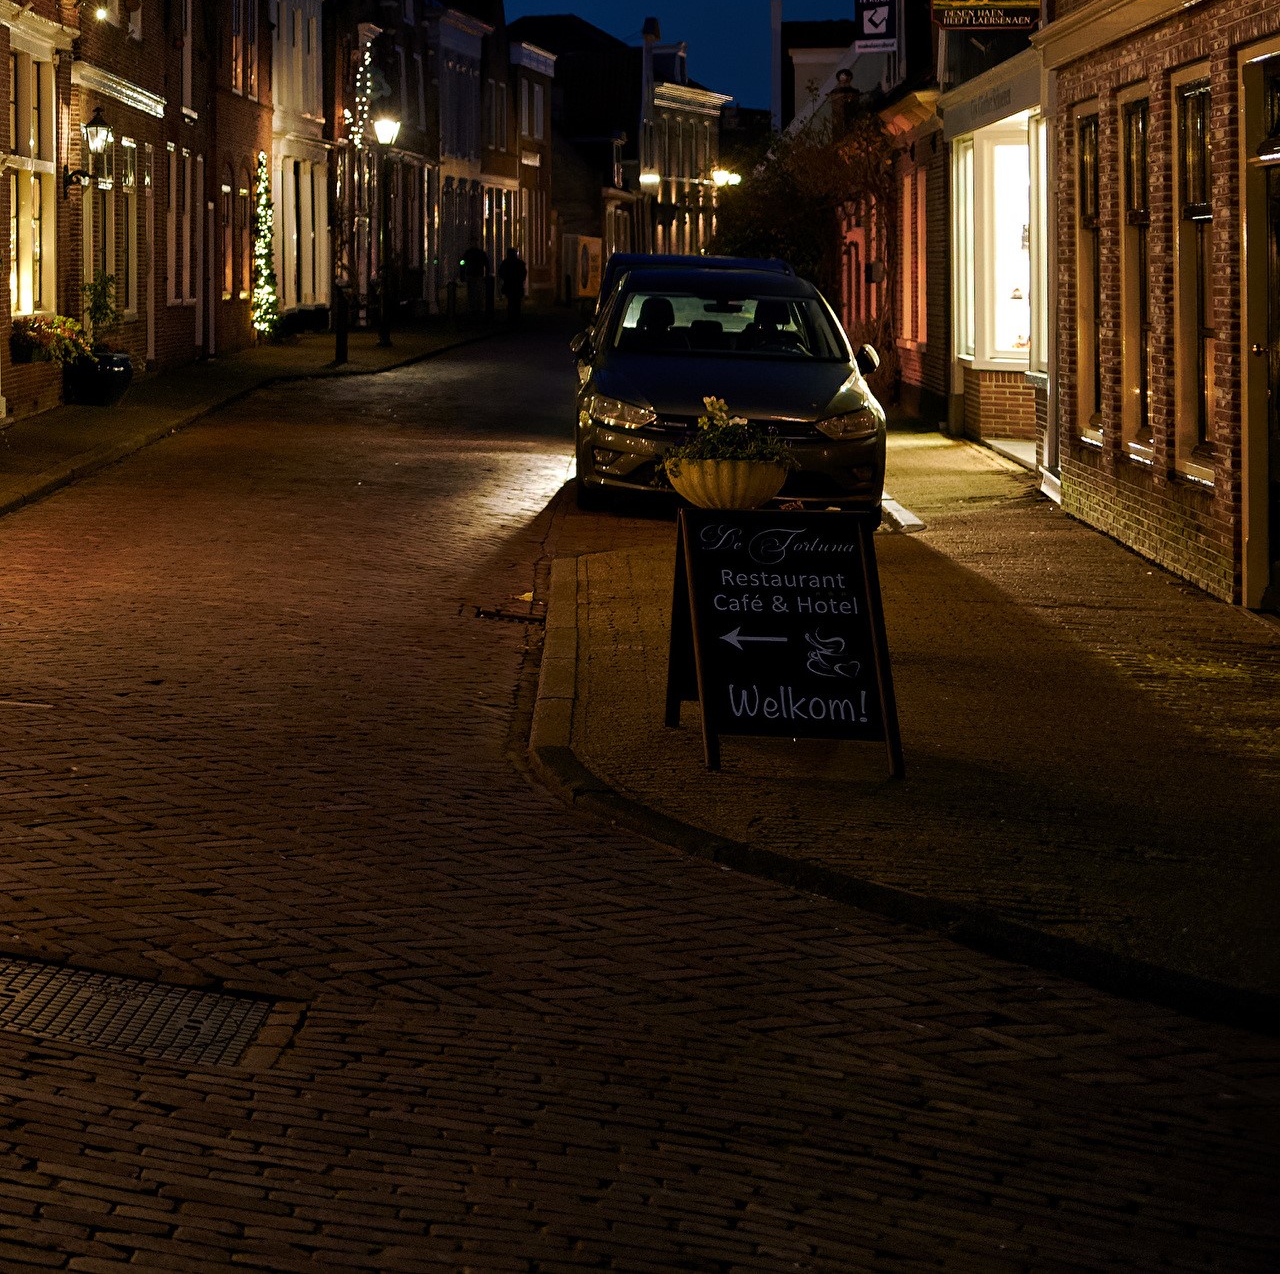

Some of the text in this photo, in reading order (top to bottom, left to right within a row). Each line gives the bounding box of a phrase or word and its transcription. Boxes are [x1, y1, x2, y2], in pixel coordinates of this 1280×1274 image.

[700, 525, 855, 565] De Fortuna
[721, 569, 846, 589] Restaurant
[714, 594, 858, 615] Café & Hotel
[728, 683, 868, 723] Welkom!
